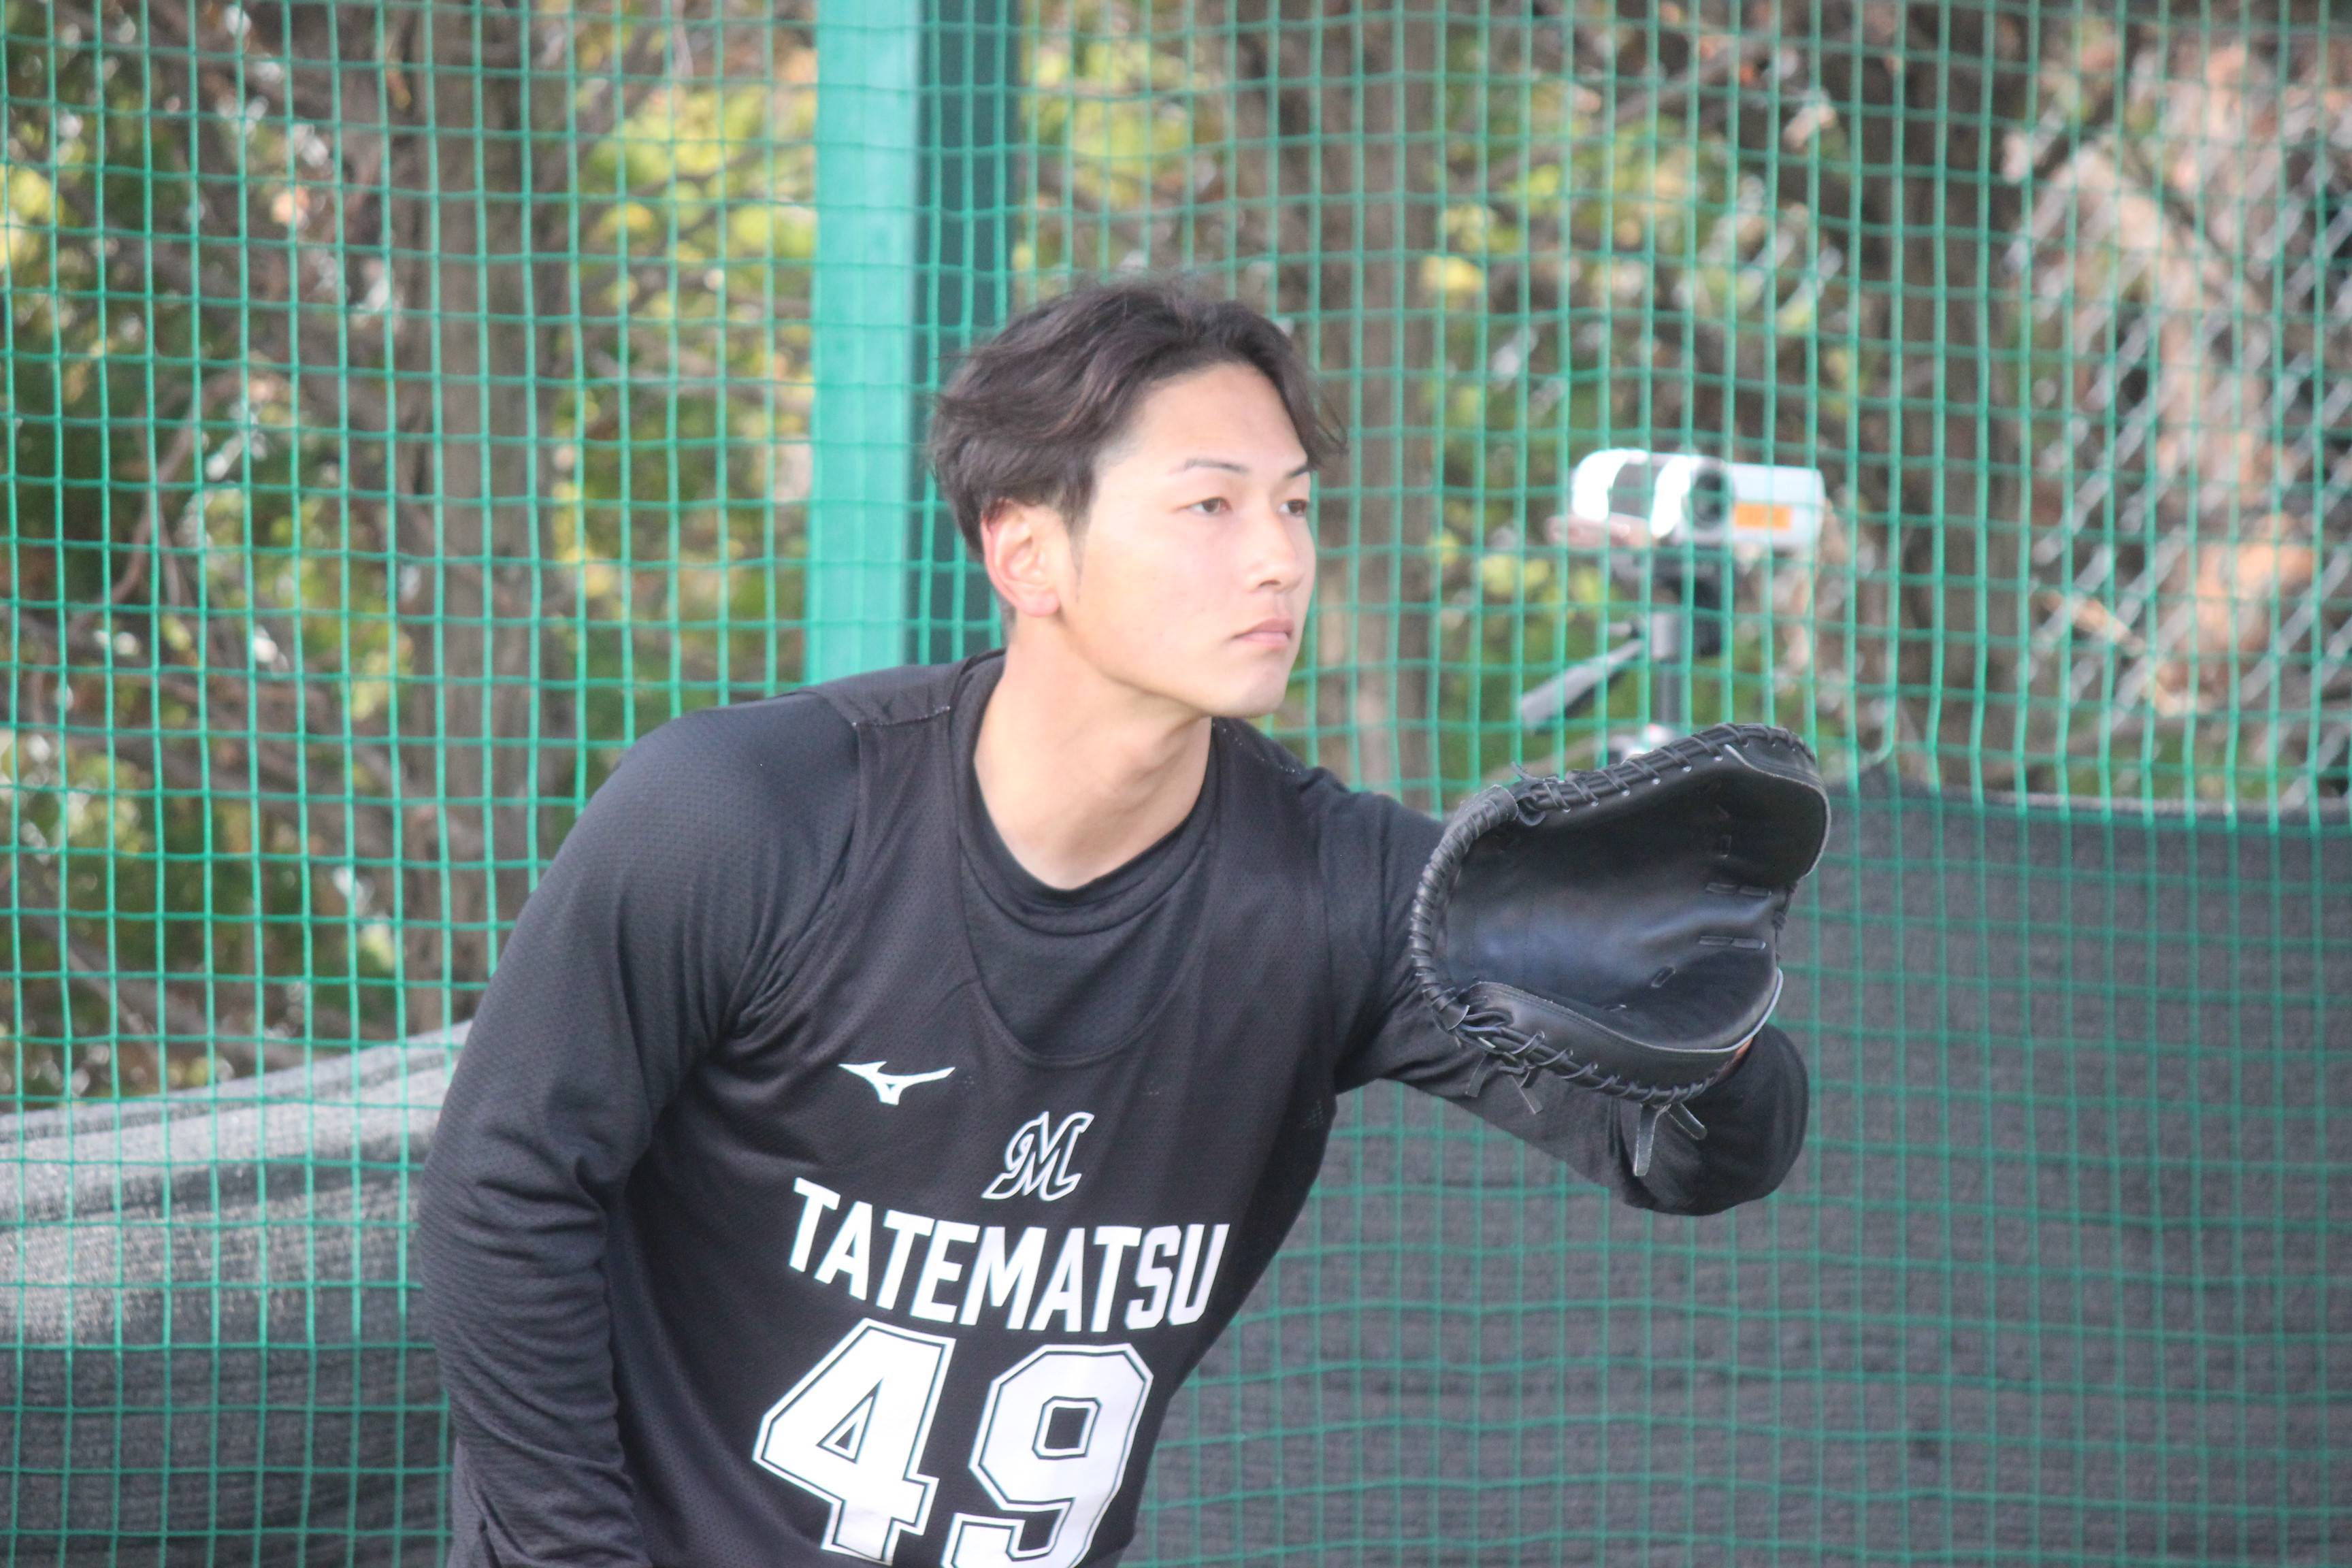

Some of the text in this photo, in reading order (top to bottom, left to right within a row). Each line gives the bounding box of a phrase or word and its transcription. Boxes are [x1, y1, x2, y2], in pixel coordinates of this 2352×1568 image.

[982, 1111, 1094, 1201] M
[789, 1176, 1230, 1333] TATEMATSU
[752, 1317, 1154, 1568] 49
